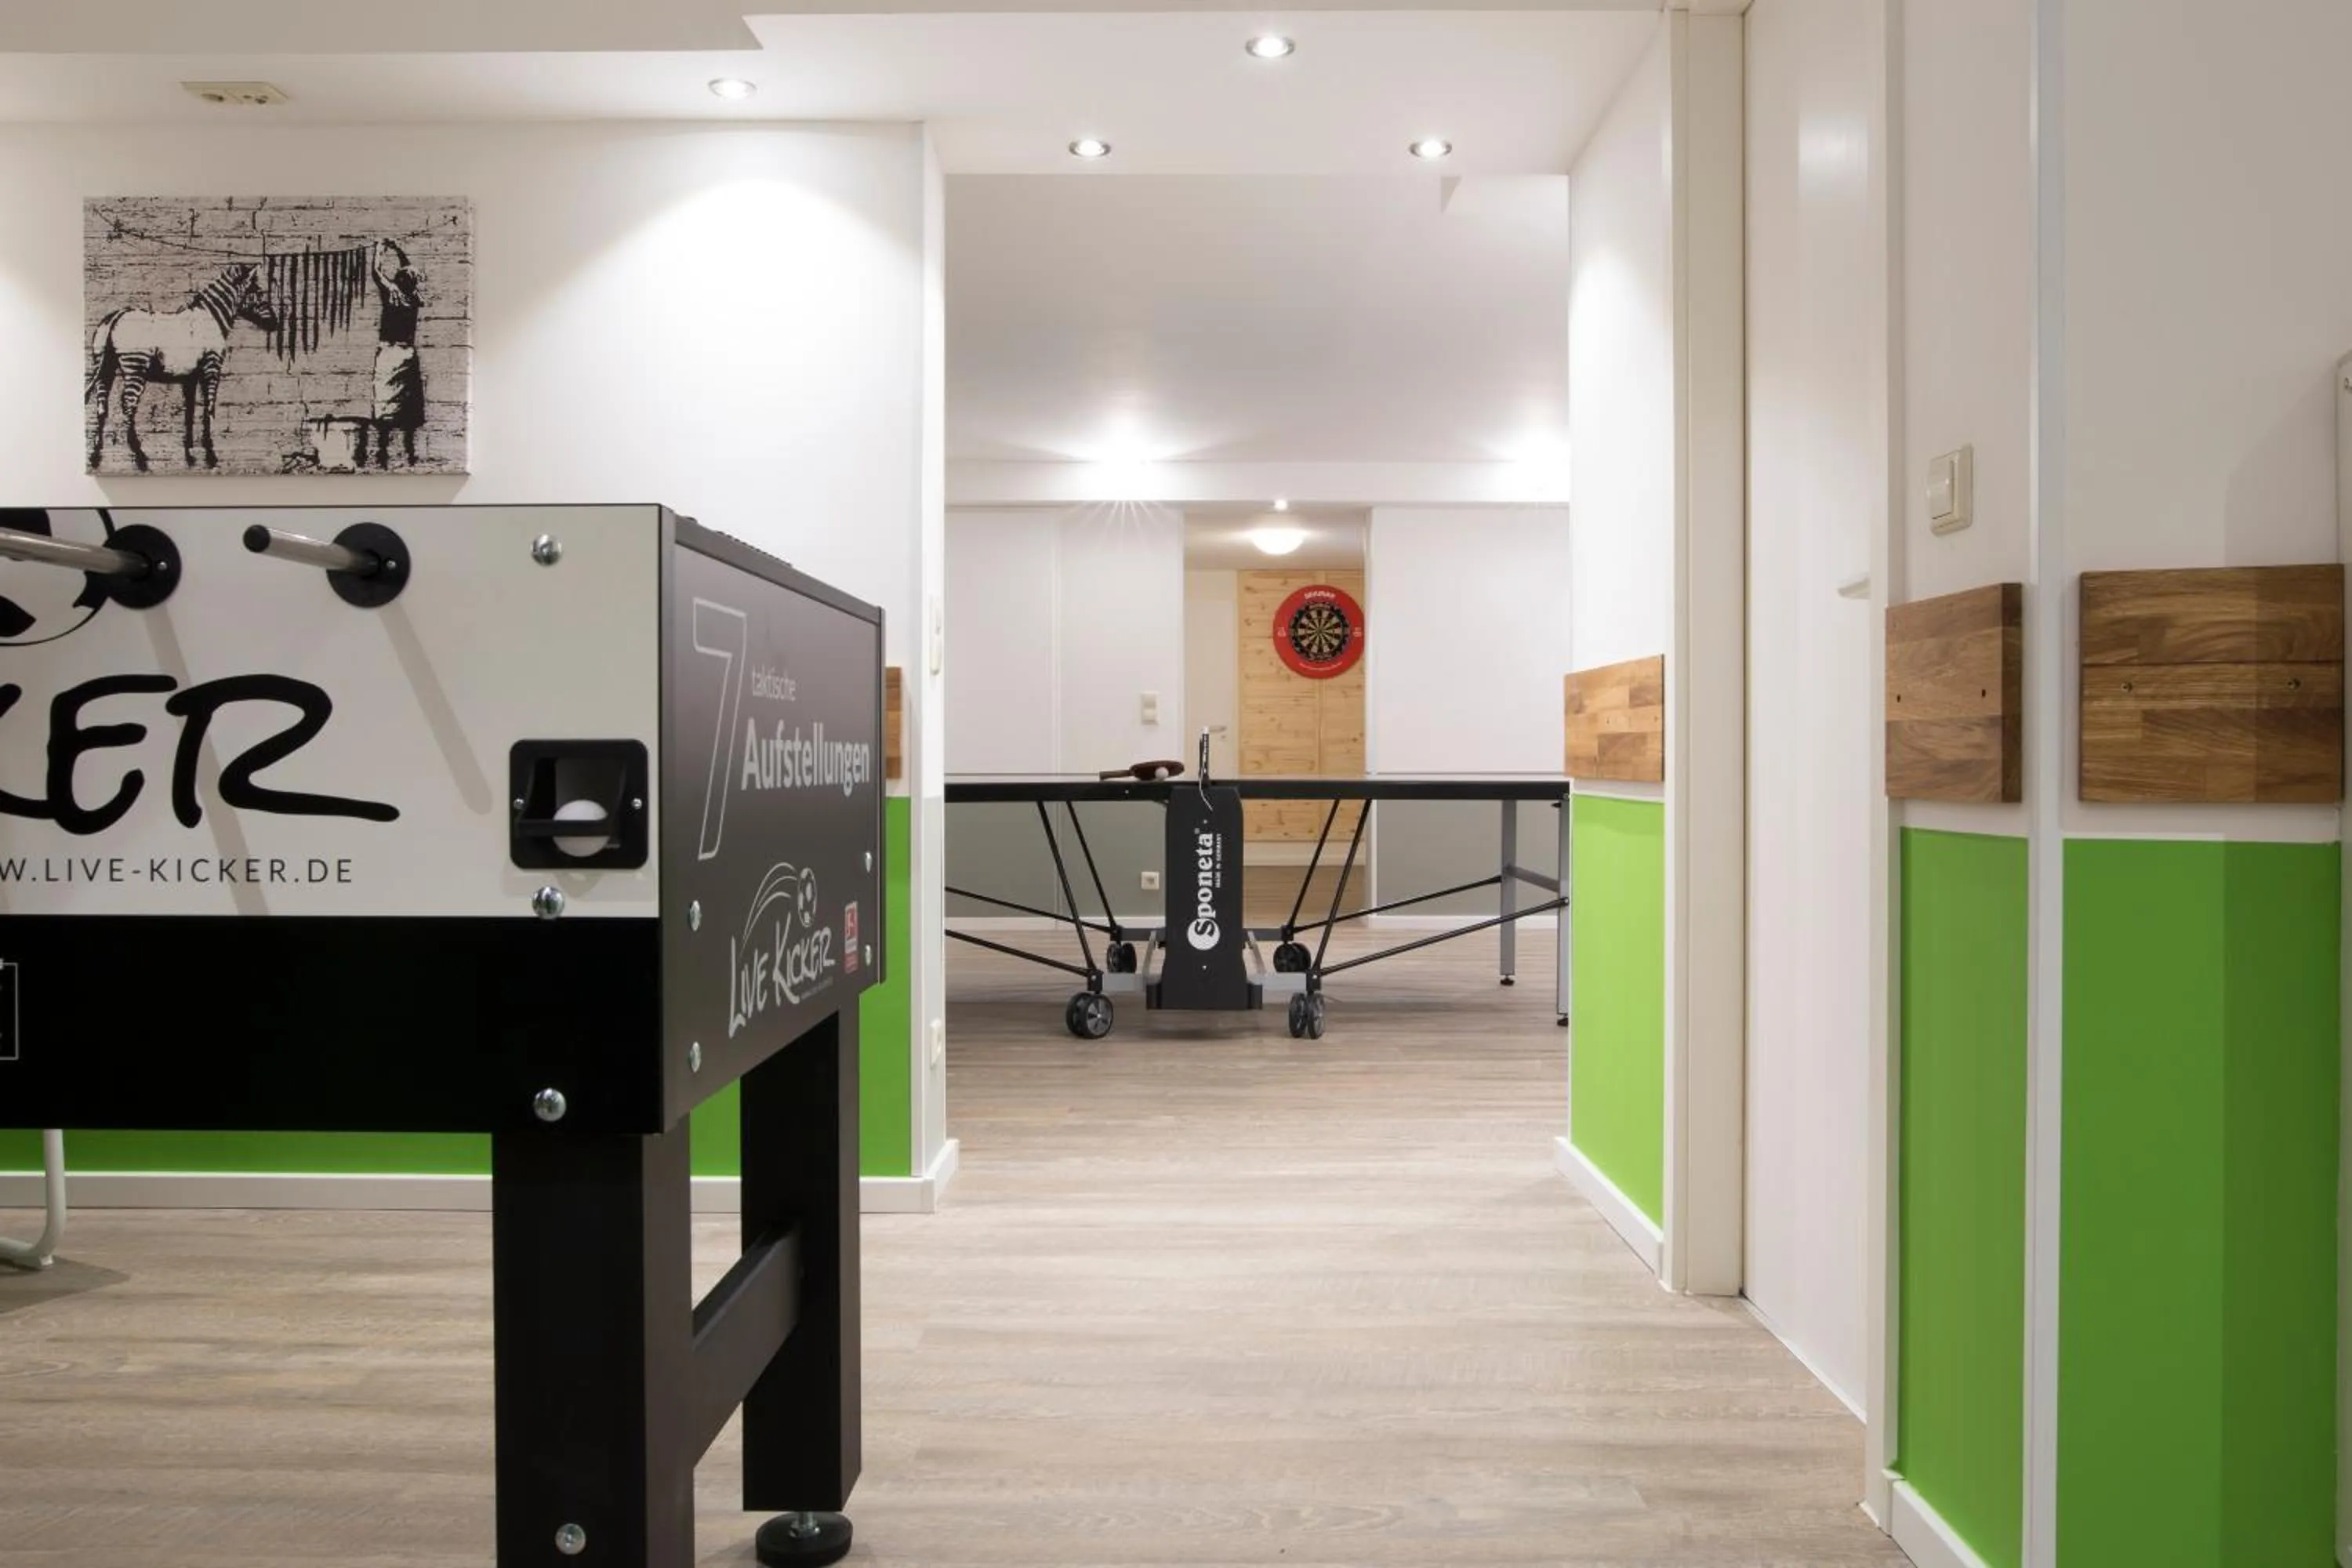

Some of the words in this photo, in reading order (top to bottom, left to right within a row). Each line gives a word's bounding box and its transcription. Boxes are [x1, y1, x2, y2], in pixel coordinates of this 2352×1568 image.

[752, 665, 797, 702] taktische
[741, 717, 870, 797] Aufstellungen
[1192, 832, 1217, 939] Sponeta
